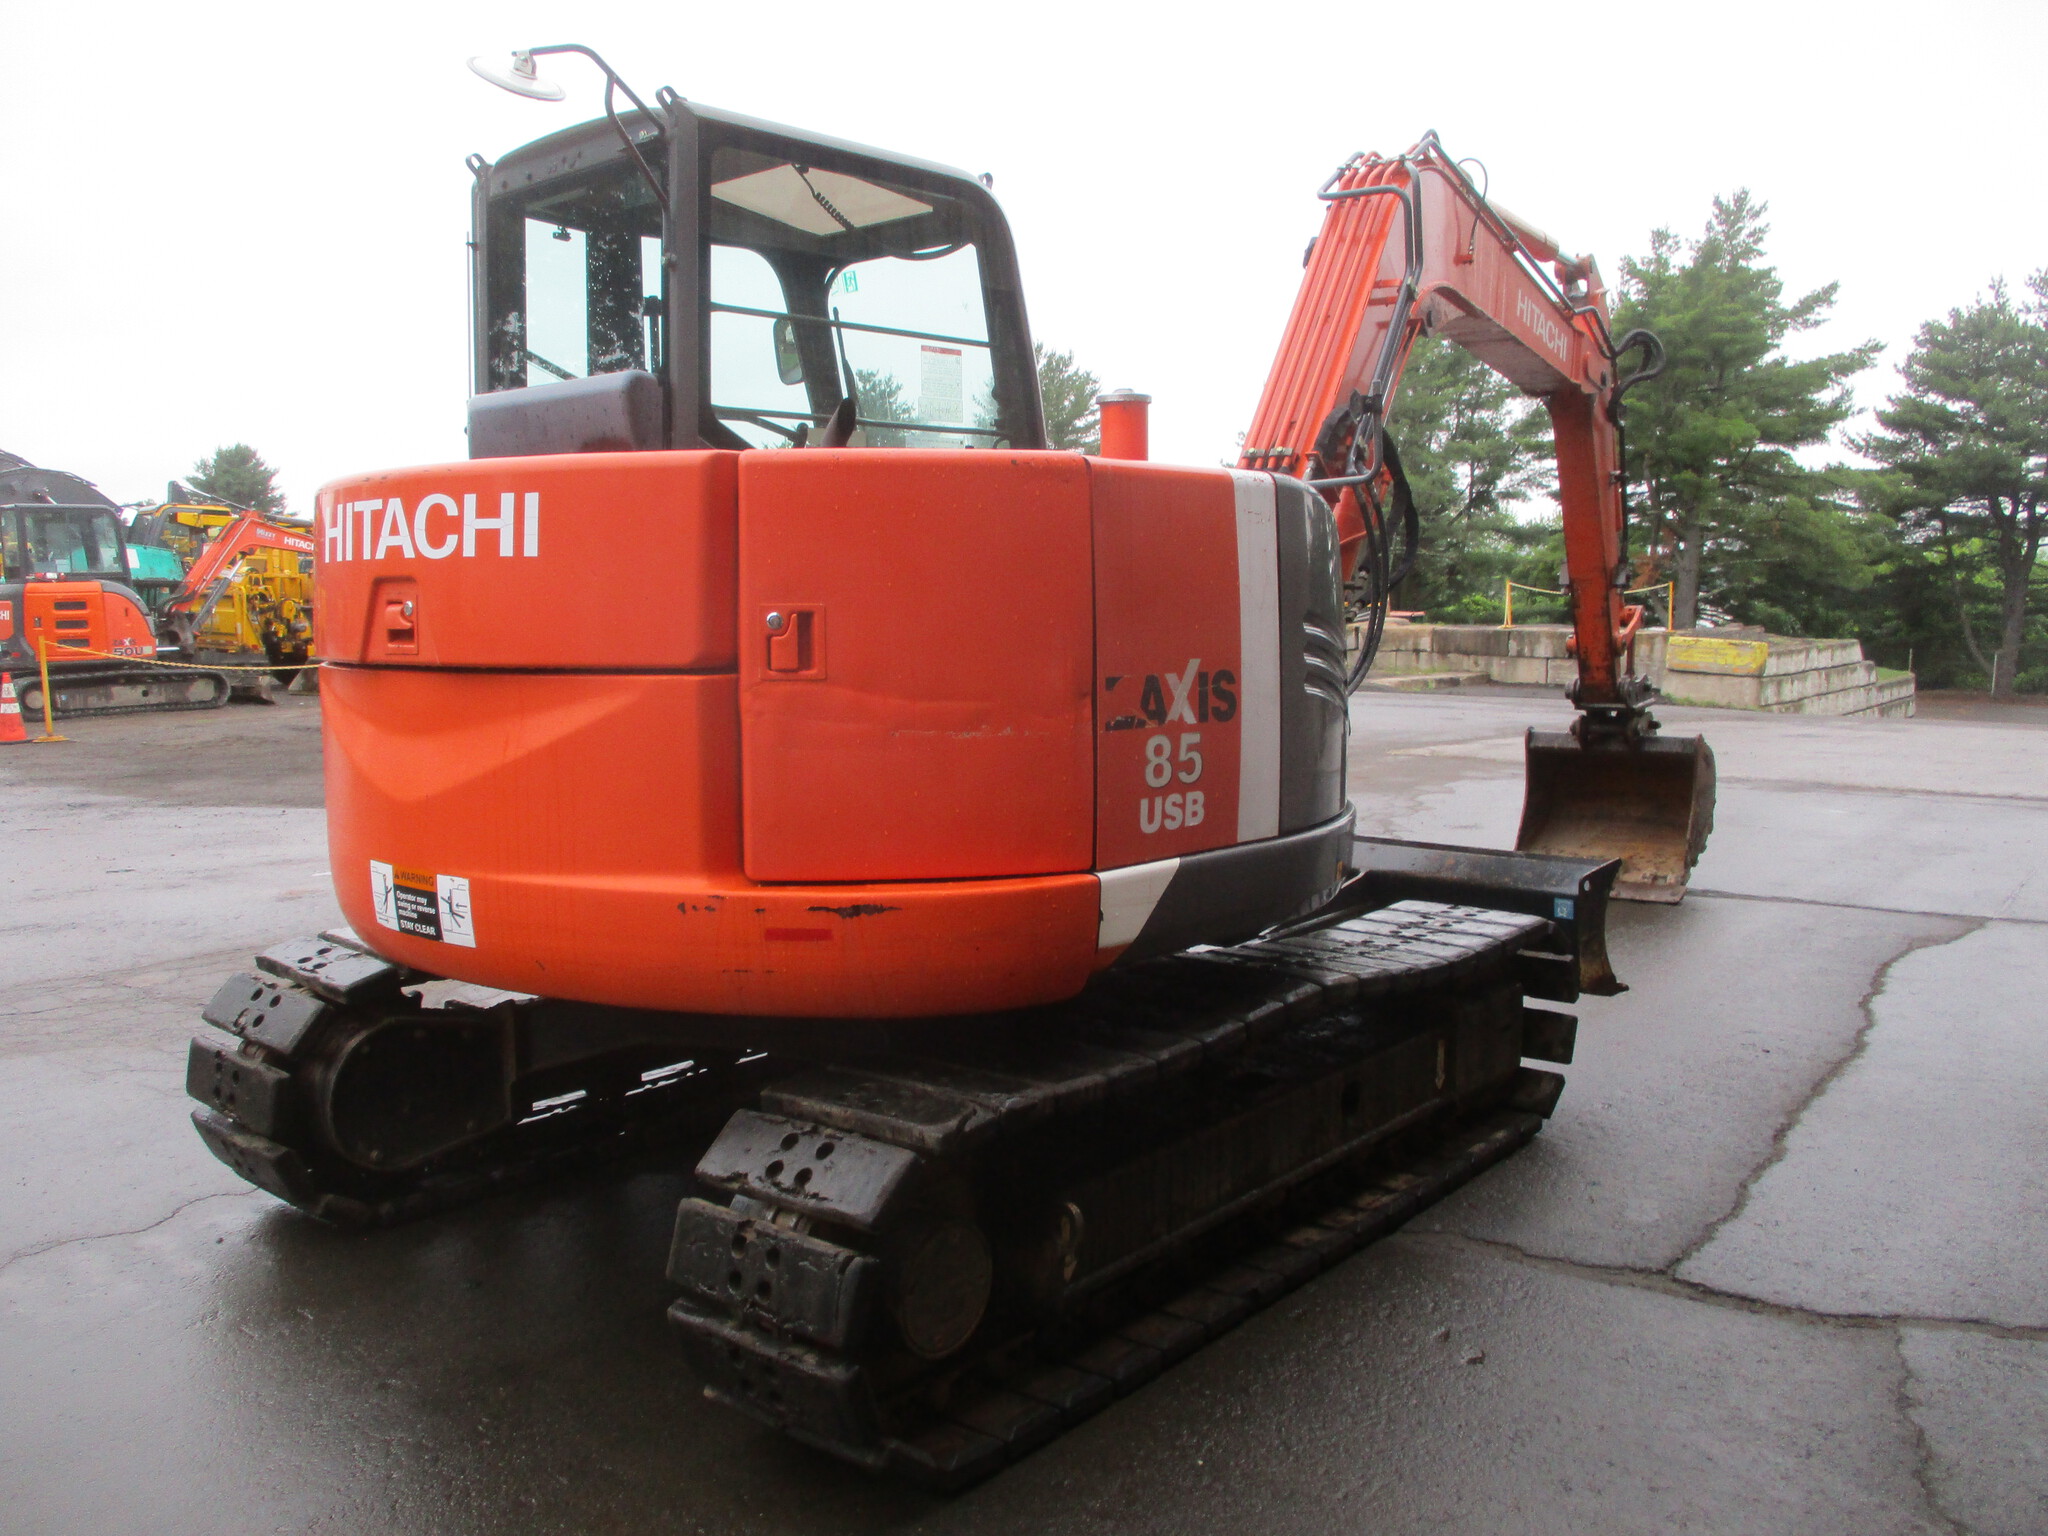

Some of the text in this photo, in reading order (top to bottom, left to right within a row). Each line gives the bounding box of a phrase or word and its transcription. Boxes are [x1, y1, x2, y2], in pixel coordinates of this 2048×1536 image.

[1516, 288, 1568, 362] HITACHI
[324, 491, 540, 563] HITACHI
[113, 647, 144, 656] 50U
[1145, 732, 1204, 788] 85
[1140, 790, 1205, 834] USB
[400, 871, 434, 887] WARNING
[396, 890, 428, 906] Operator may
[416, 905, 436, 915] reverse
[400, 919, 414, 931] STAY
[414, 923, 436, 936] CLEAR
